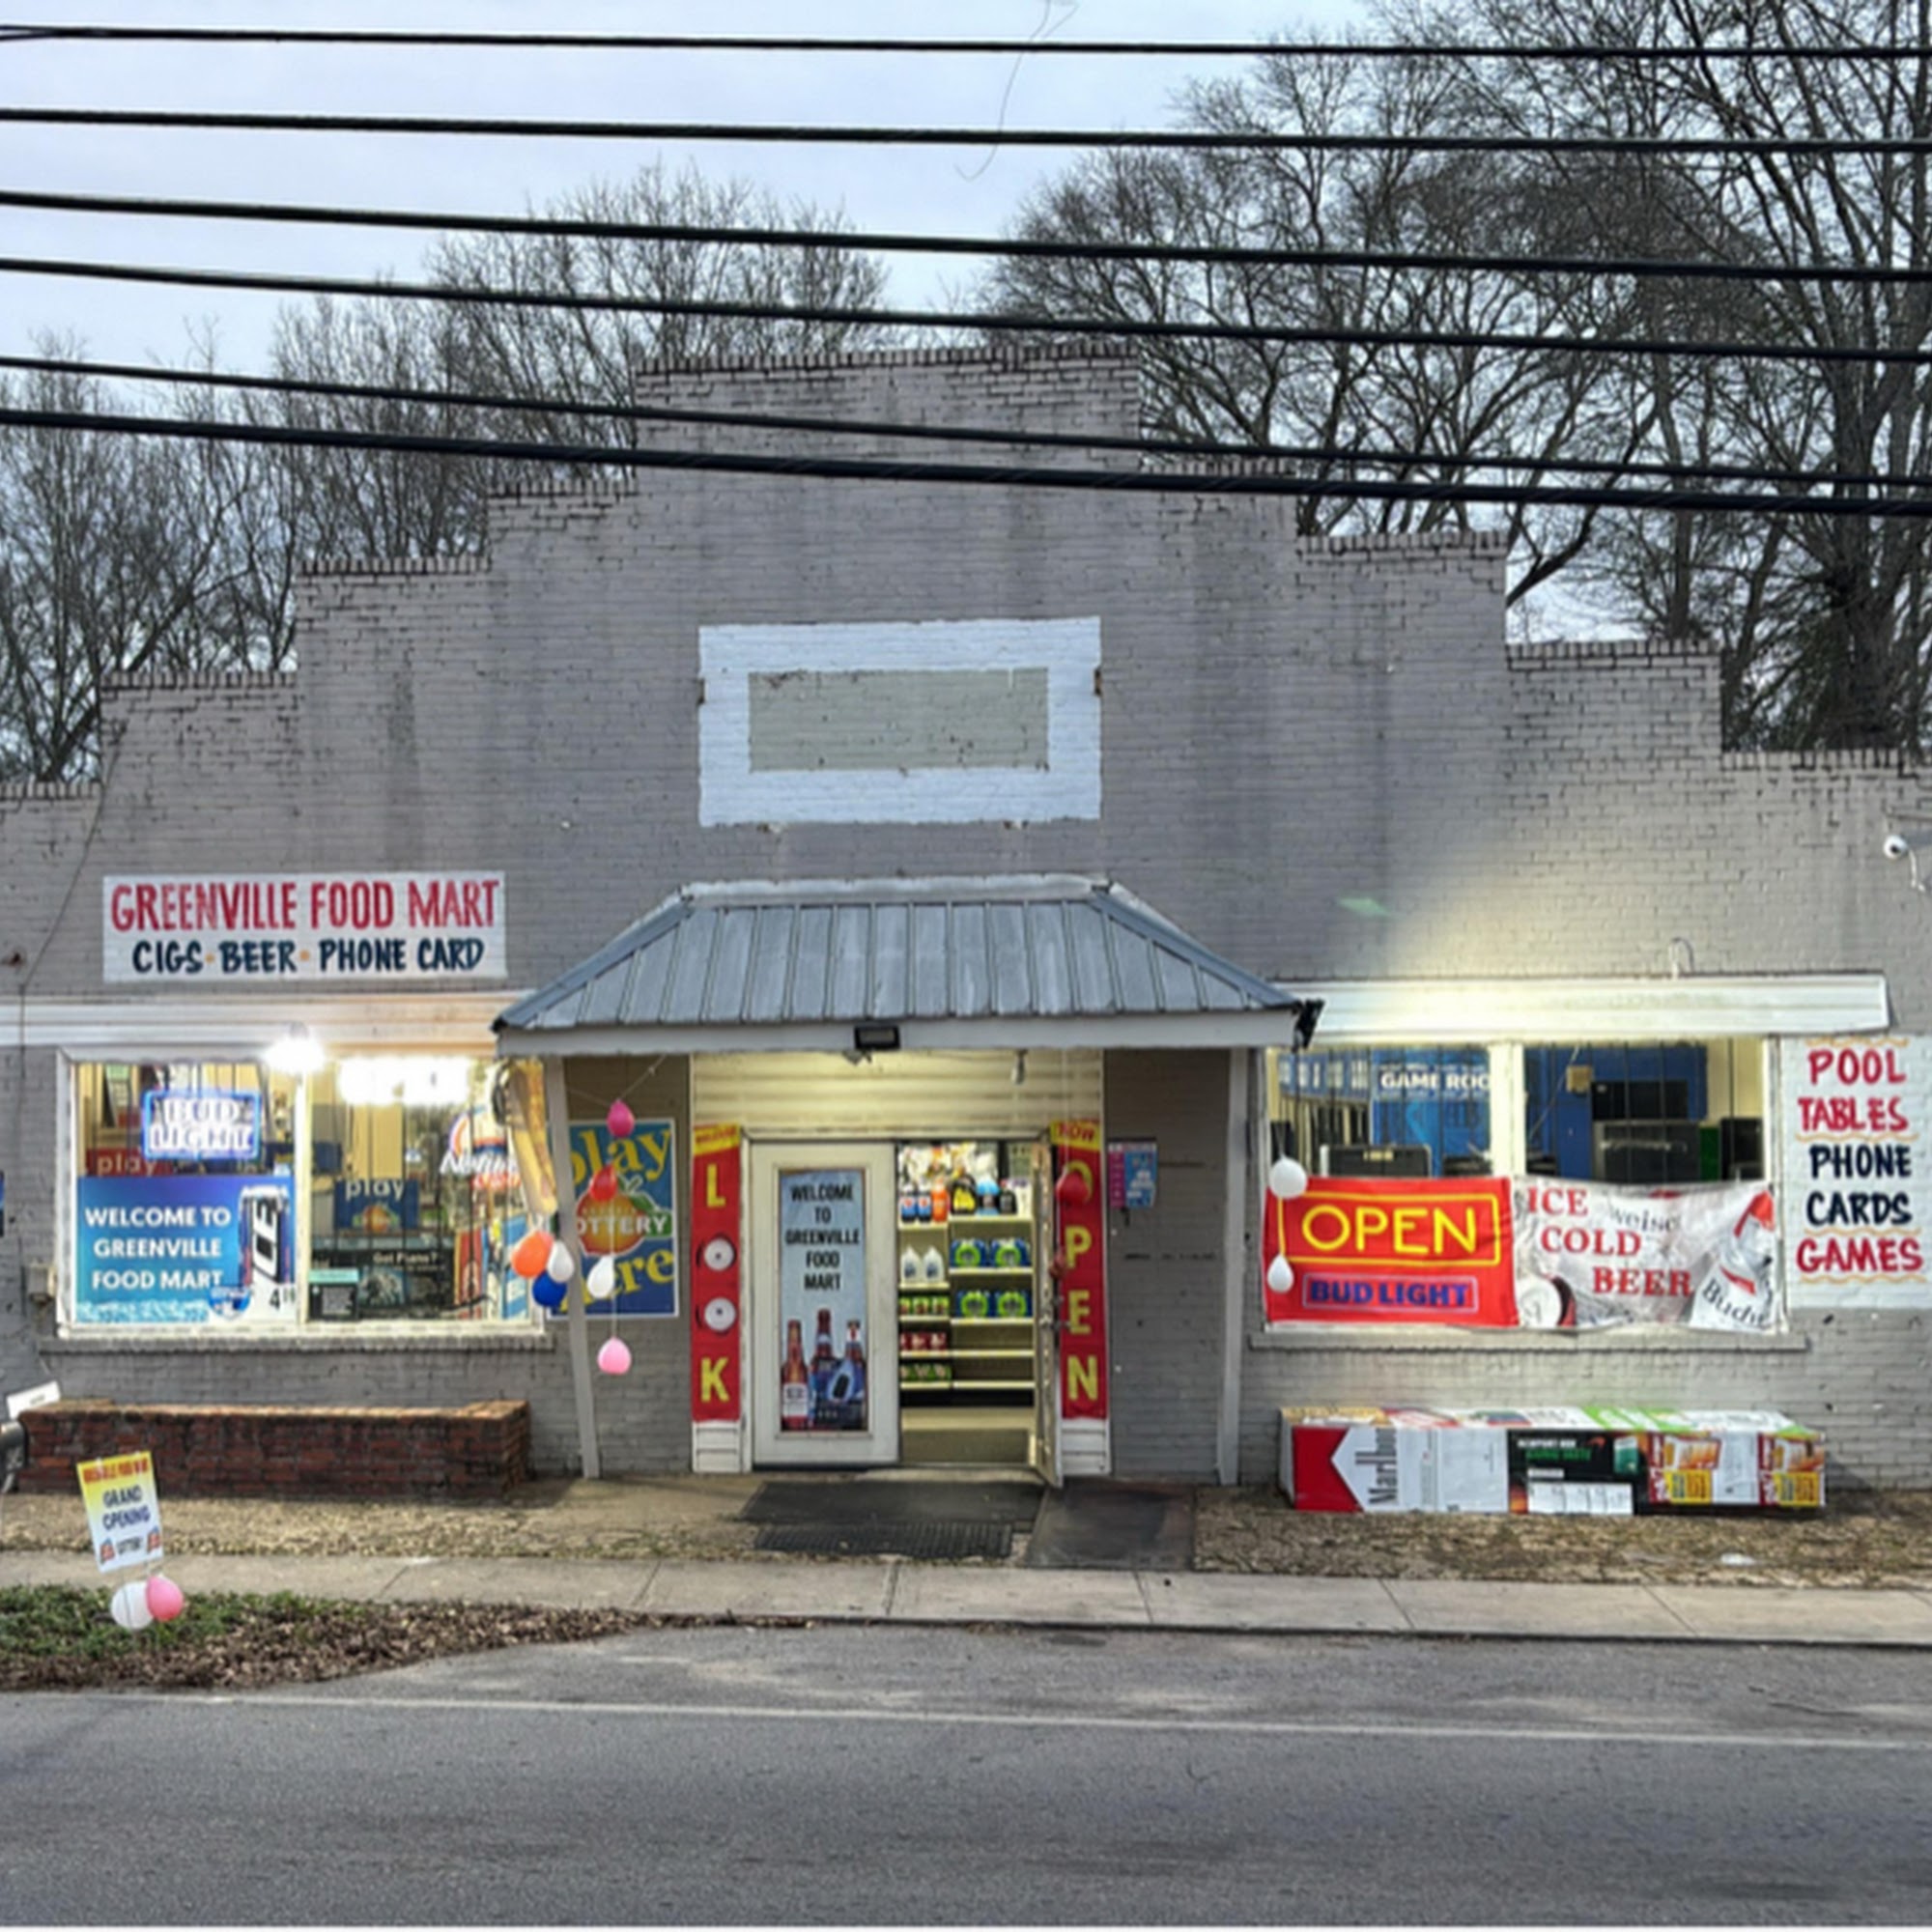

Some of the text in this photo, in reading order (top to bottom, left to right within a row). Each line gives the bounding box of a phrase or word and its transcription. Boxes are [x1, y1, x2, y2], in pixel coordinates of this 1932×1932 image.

[110, 879, 499, 931] GREENVILLE FOOD MART
[132, 937, 484, 974] CIGS BEER PHONE CARD
[1807, 1048, 1907, 1086] POOL
[1380, 1070, 1440, 1091] GAME
[1446, 1071, 1491, 1091] ROO
[1797, 1095, 1909, 1132] TABLES
[98, 1152, 156, 1177] play
[1809, 1144, 1913, 1179] PHONE
[346, 1181, 405, 1201] play
[790, 1182, 853, 1202] WELCOME
[1526, 1187, 1589, 1216] ICE
[85, 1207, 232, 1228] WELCOME TO
[814, 1206, 832, 1224] TO
[1806, 1191, 1913, 1226] CARDS
[578, 1214, 668, 1236] OTTERY
[785, 1228, 860, 1245] GREENVILLE
[1303, 1204, 1476, 1255] OPEN
[94, 1237, 222, 1259] GREENVILLE
[1540, 1226, 1642, 1257] COLD
[1796, 1236, 1924, 1273] GAMES
[806, 1251, 840, 1268] FOOD
[92, 1269, 223, 1291] FOOD MART
[804, 1273, 841, 1292] MART
[1592, 1266, 1692, 1297] BEER
[1310, 1280, 1469, 1307] BUD LIGHT
